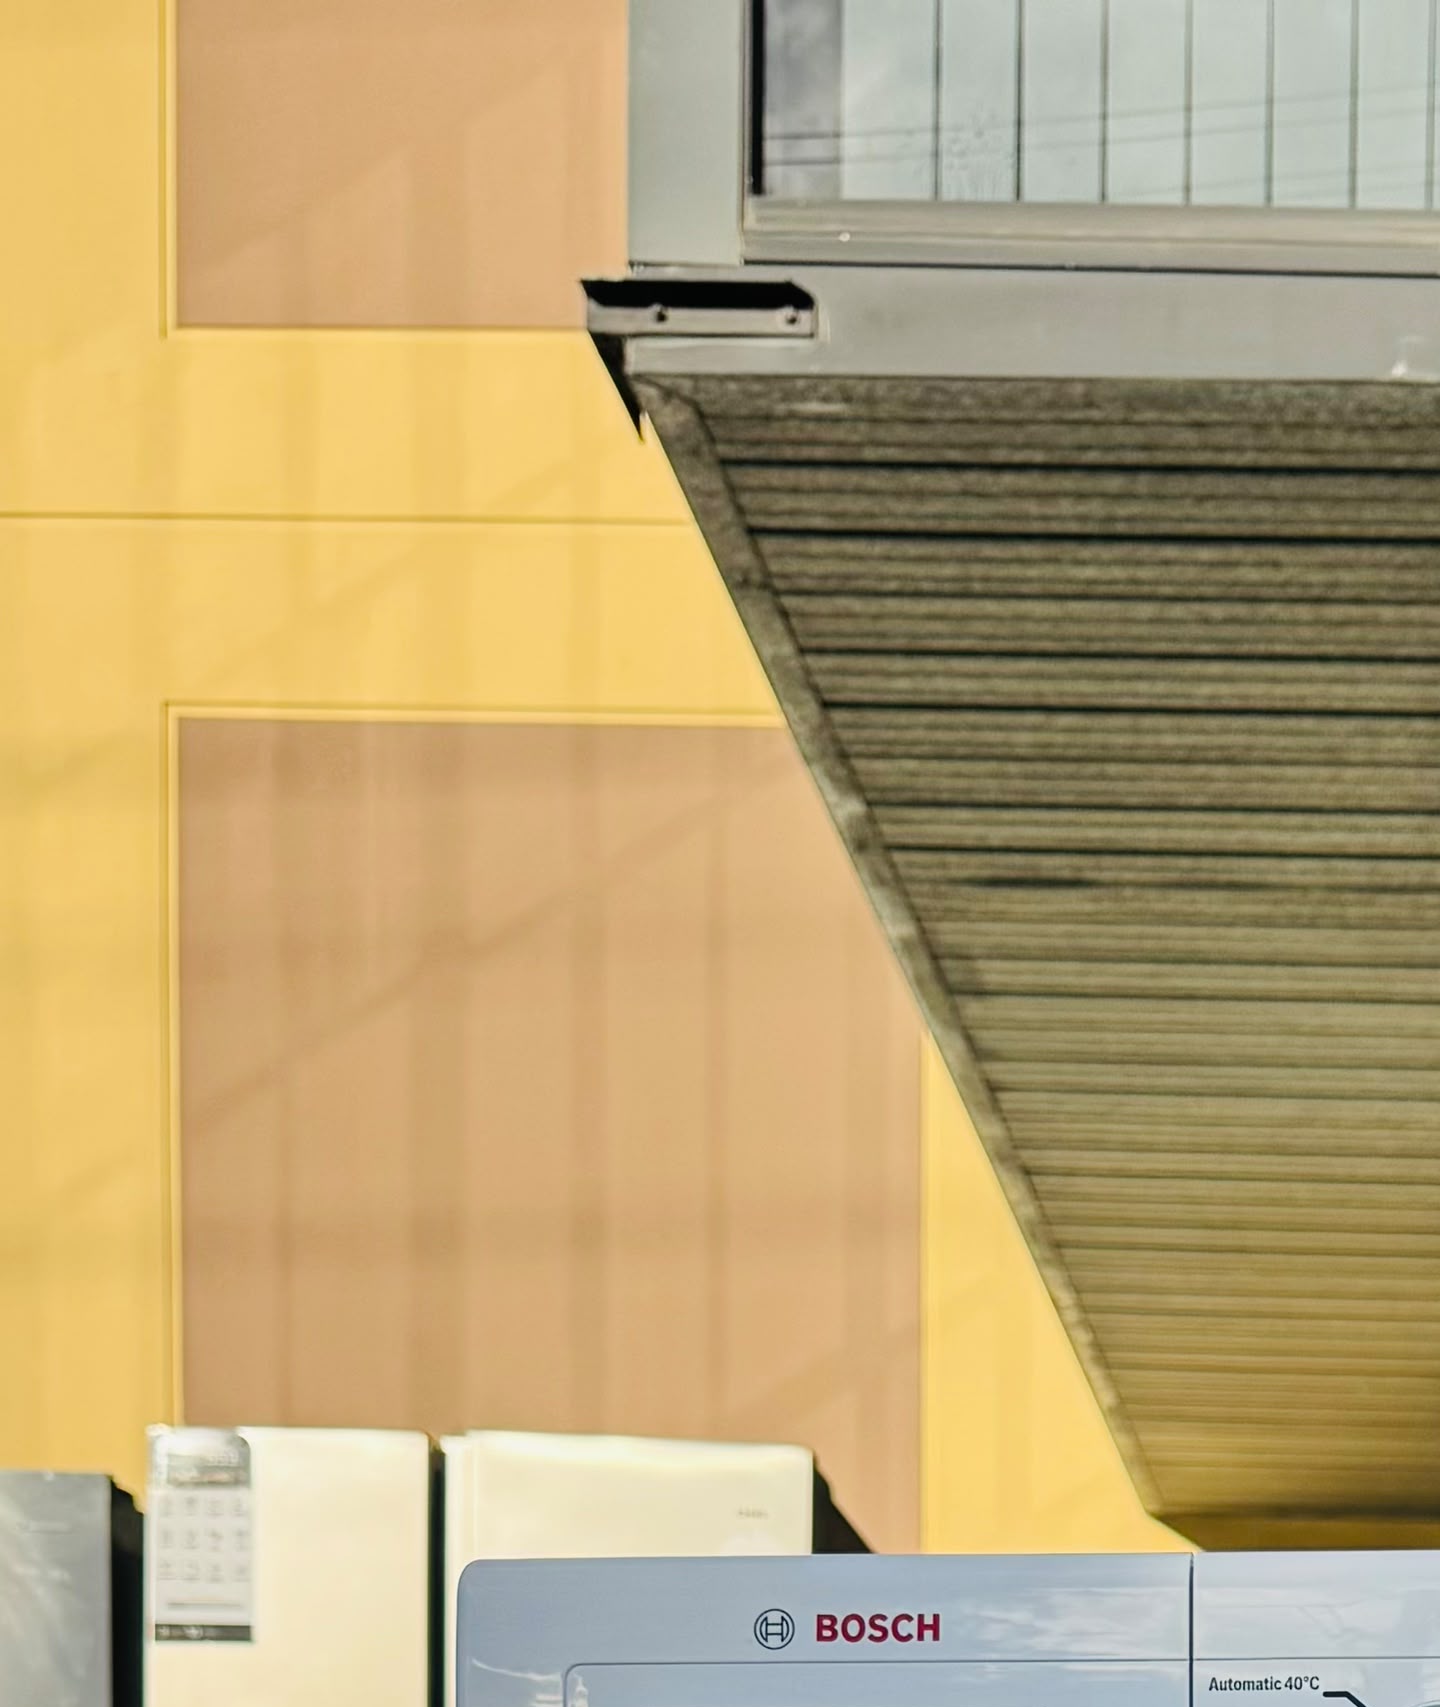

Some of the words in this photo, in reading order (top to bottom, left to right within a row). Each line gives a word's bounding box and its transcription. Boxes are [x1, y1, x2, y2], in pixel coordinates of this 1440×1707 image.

[816, 1613, 941, 1643] BOSCH
[1208, 1676, 1281, 1692] Automatic
[1285, 1675, 1320, 1692] 40°C
